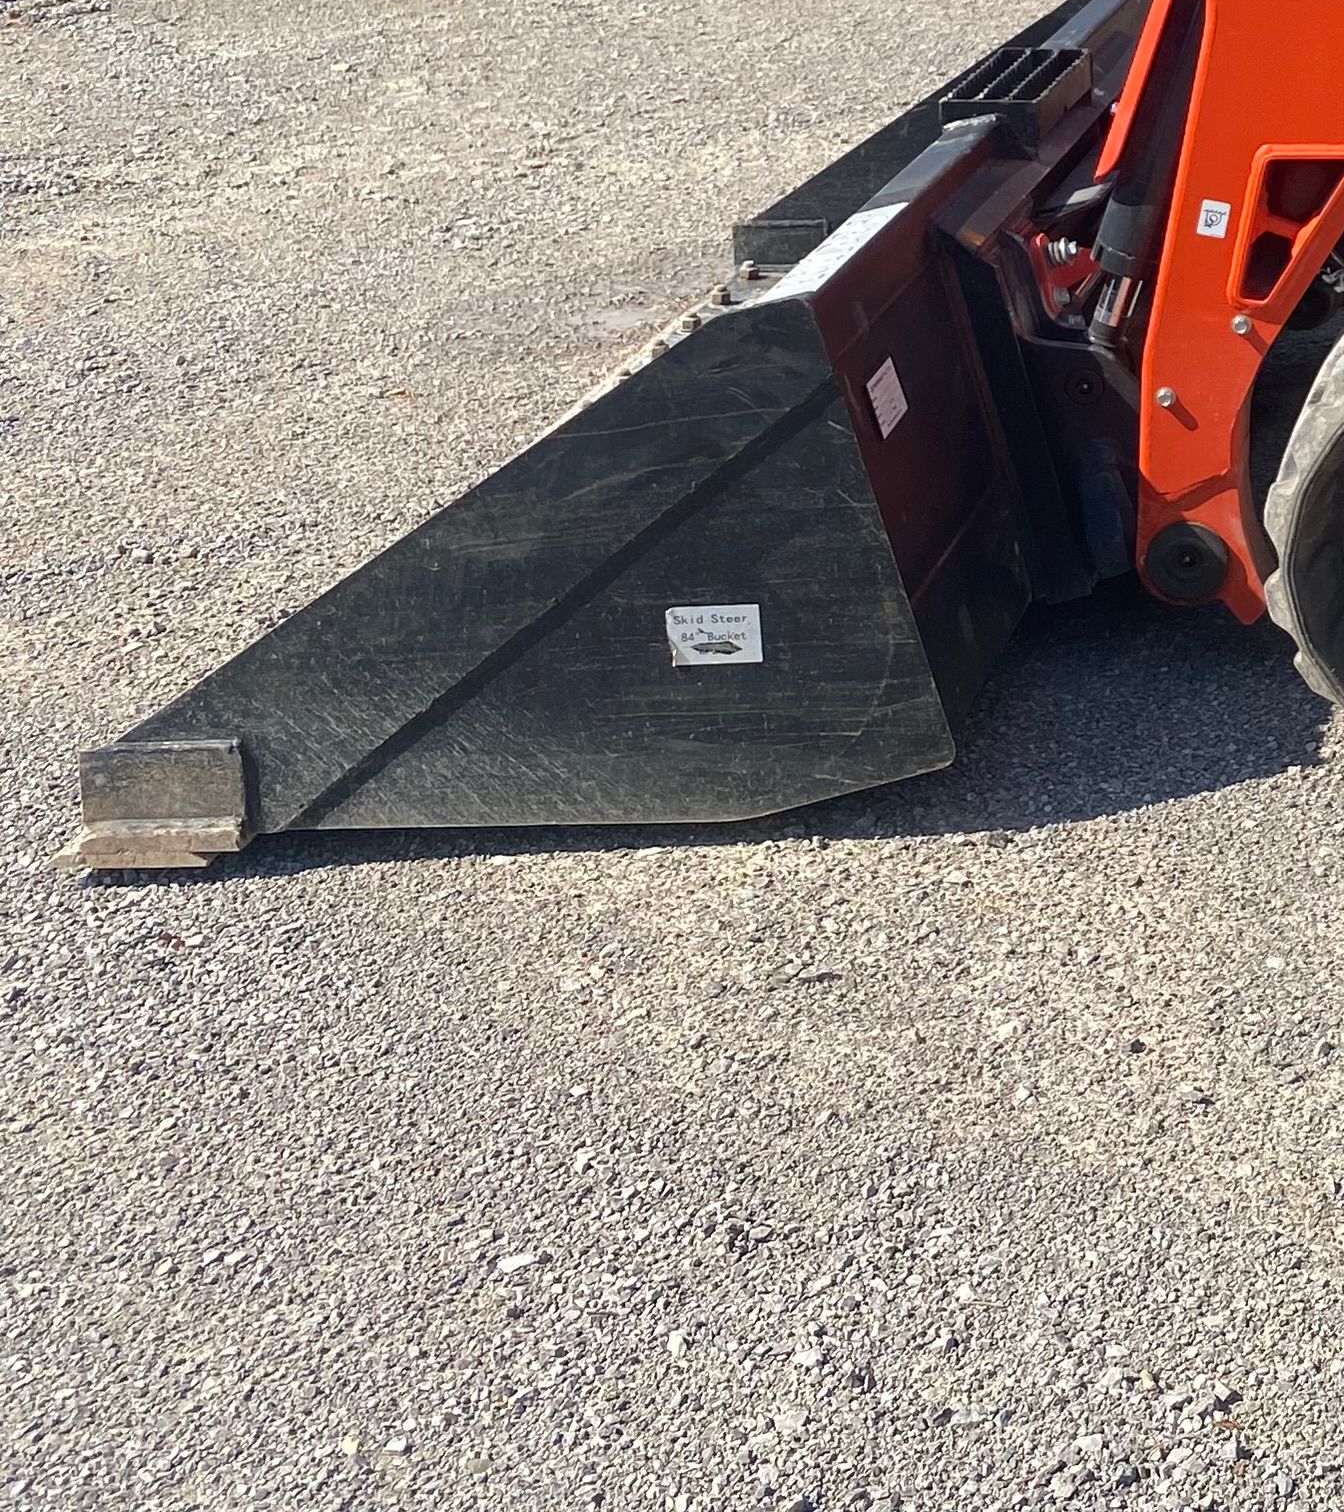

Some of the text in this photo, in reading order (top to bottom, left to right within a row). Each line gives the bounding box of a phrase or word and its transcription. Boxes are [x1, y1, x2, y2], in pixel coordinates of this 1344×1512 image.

[673, 614, 748, 625] Skid Steer
[707, 631, 747, 641] Bucket
